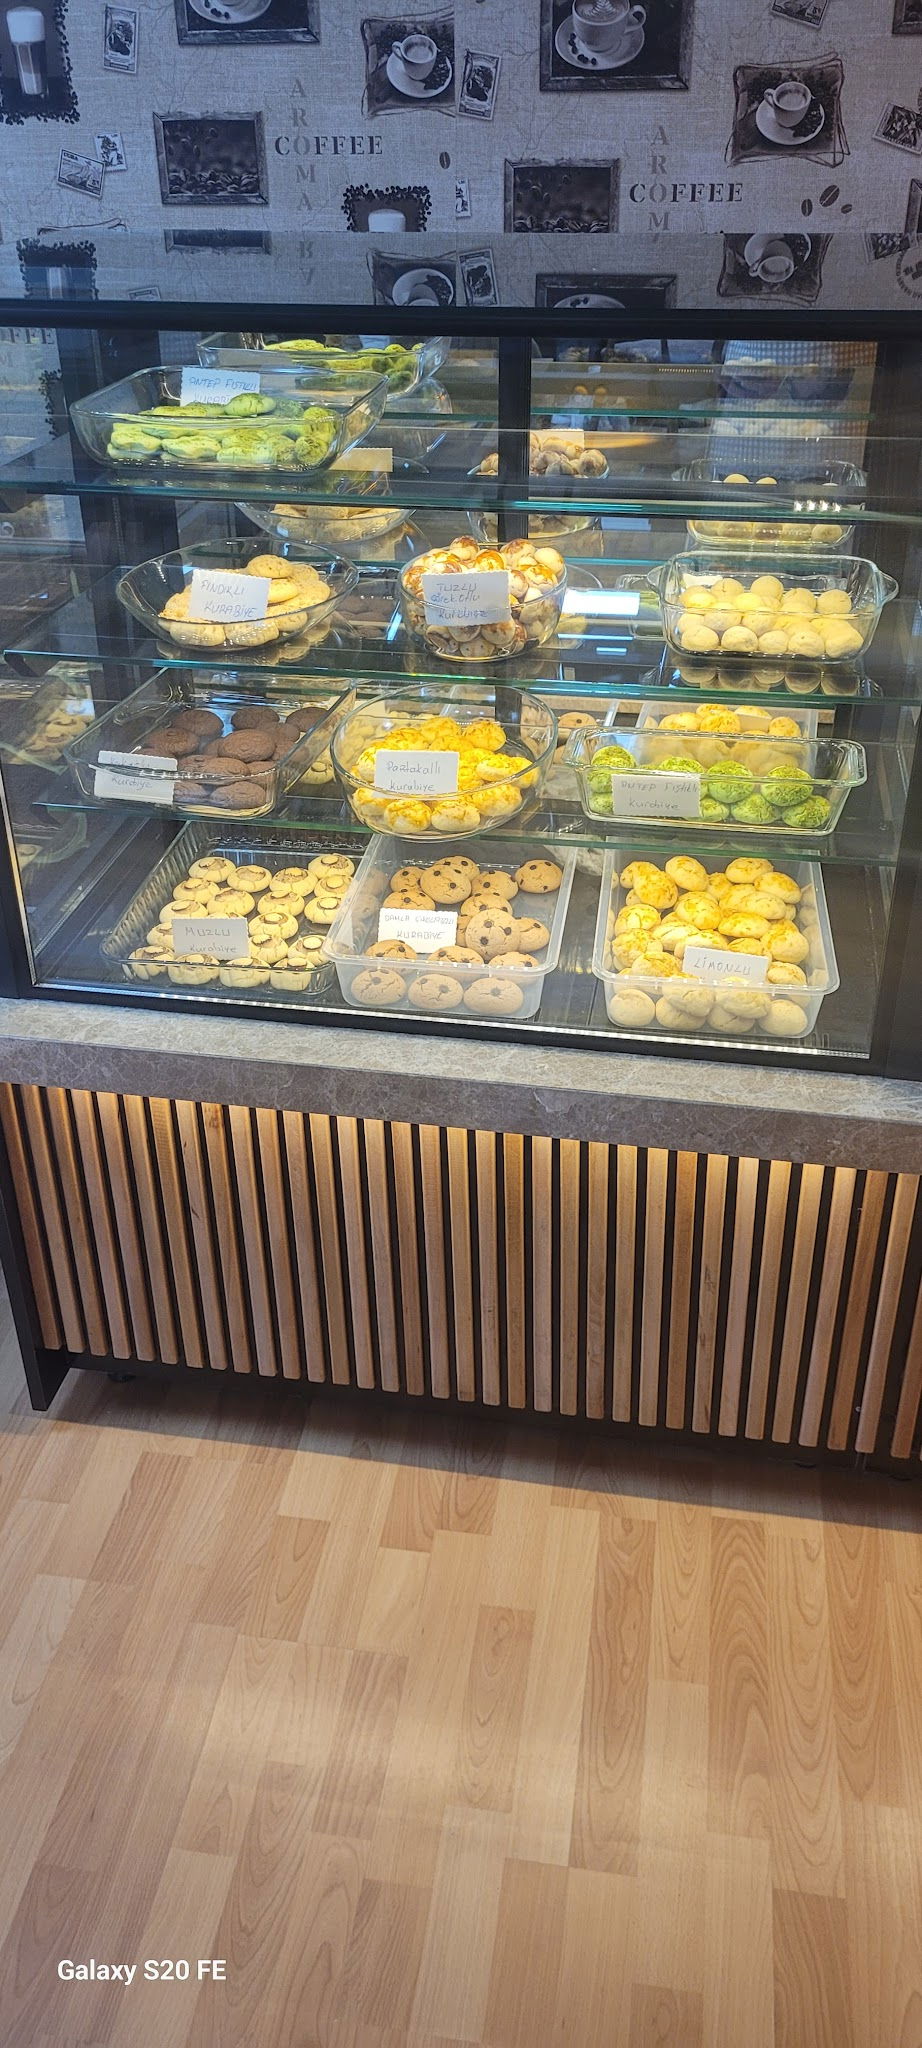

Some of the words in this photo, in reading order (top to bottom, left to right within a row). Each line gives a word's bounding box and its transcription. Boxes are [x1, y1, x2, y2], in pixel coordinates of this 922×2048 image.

[274, 135, 383, 155] COFFEE
[648, 126, 670, 231] AROM
[629, 183, 743, 203] COFFEE
[190, 376, 221, 389] ANTEP
[184, 926, 231, 937] MUZLU
